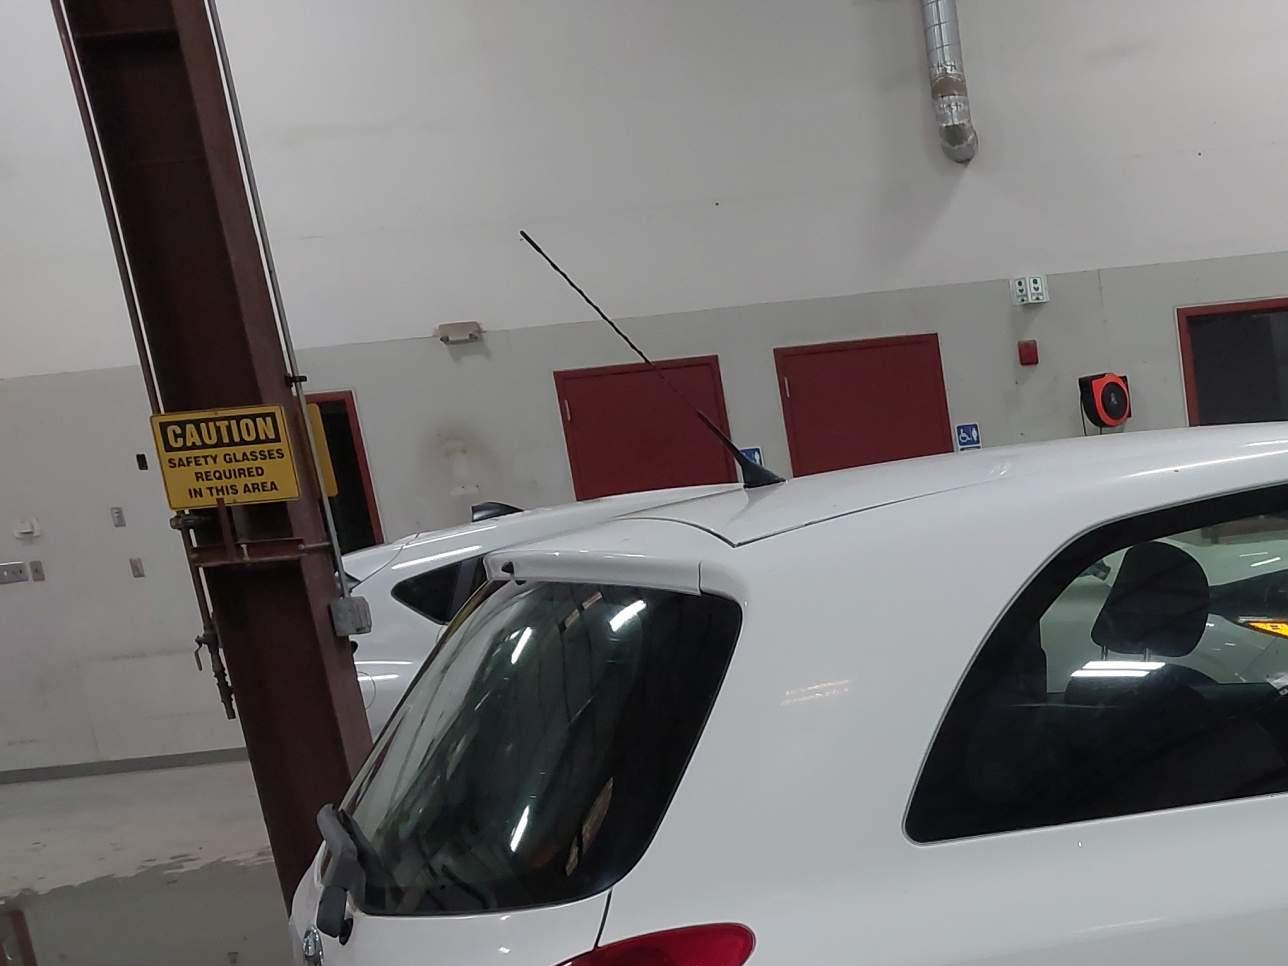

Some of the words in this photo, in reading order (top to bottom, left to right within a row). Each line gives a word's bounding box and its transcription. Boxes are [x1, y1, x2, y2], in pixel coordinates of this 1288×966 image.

[166, 416, 276, 449] CAUTION
[168, 454, 218, 468] SAFETY
[223, 449, 285, 464] GLASSES
[195, 467, 265, 482] REQUIRED
[188, 487, 203, 498] IN
[206, 484, 238, 496] THIS
[243, 481, 278, 494] AREA
